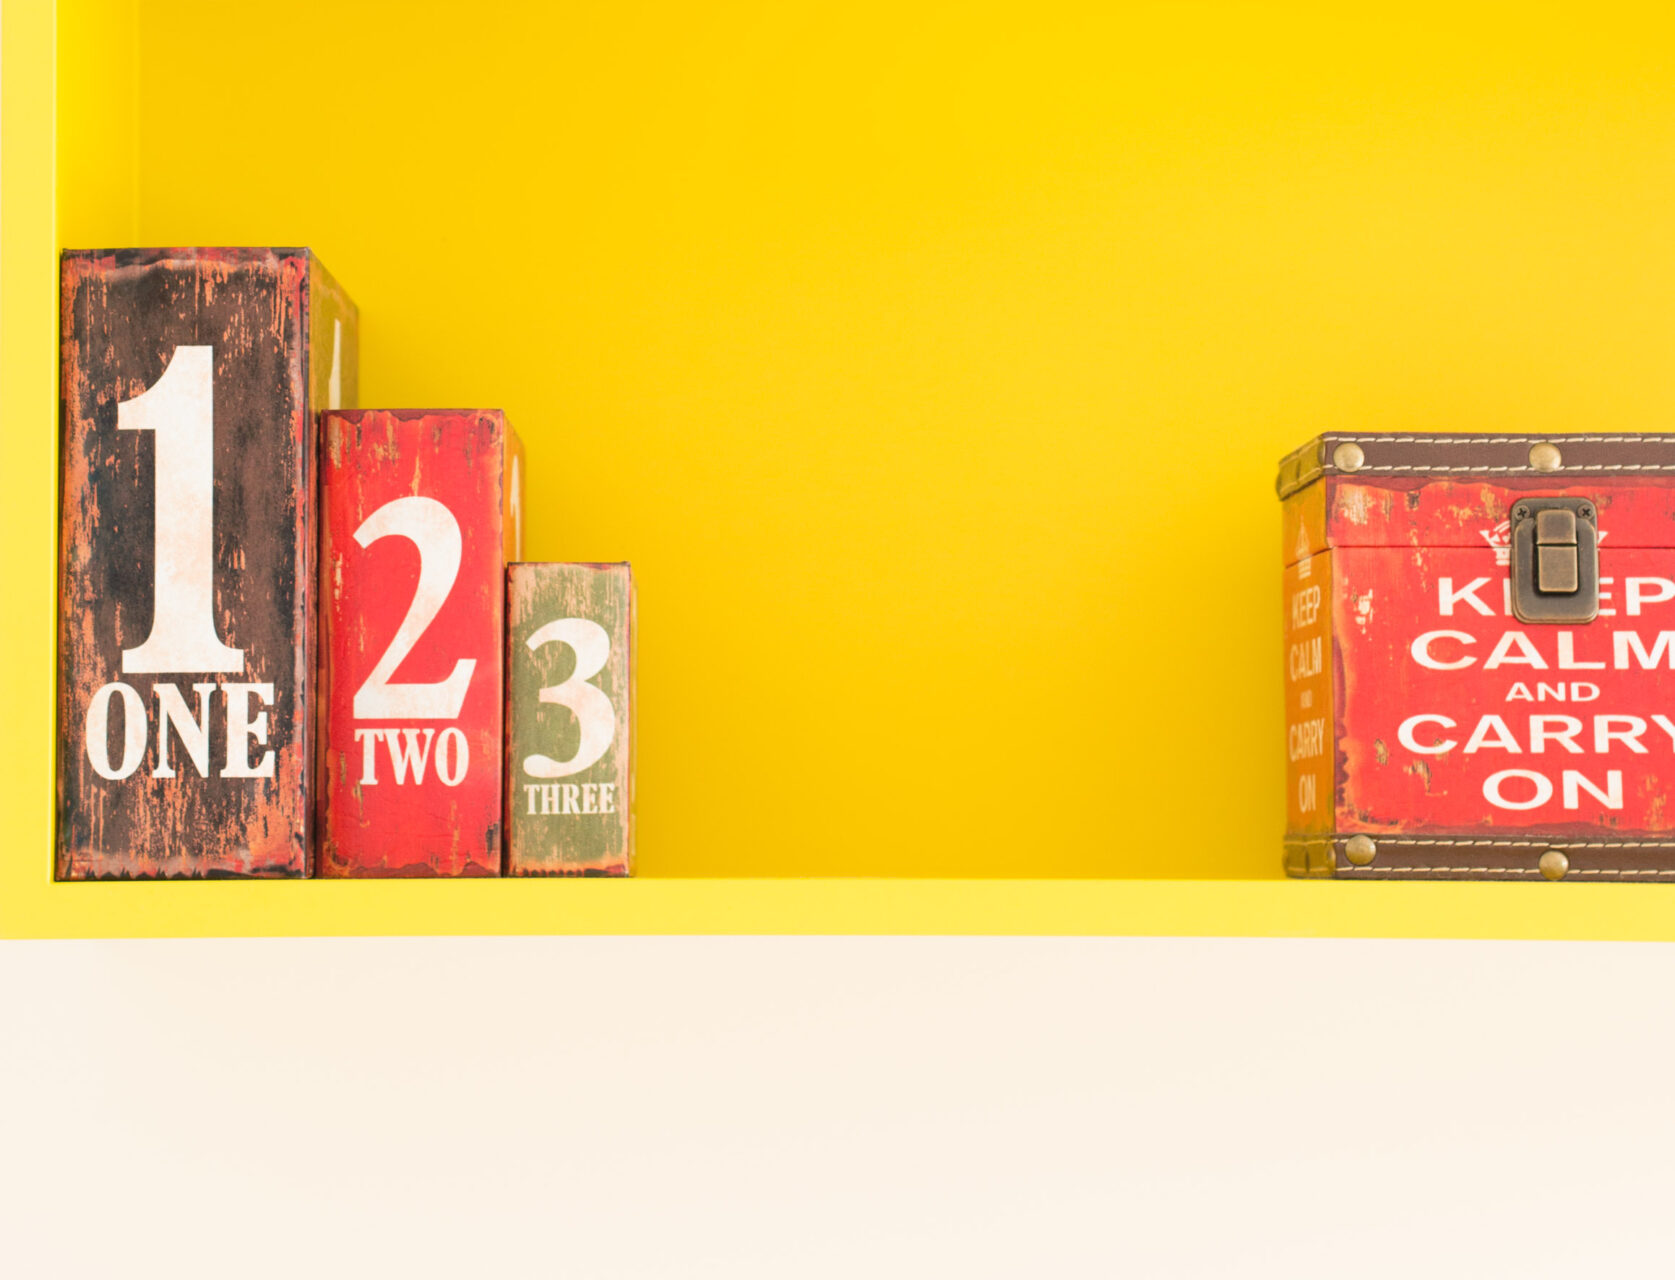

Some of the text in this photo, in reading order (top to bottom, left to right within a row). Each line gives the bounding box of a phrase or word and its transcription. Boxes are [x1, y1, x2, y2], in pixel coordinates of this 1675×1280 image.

[118, 346, 243, 673] 1
[354, 496, 476, 718] 2
[1292, 585, 1321, 630] KEEP
[1439, 577, 1675, 615] KP
[1289, 636, 1322, 682] CALM
[1411, 631, 1675, 669] CALM
[524, 618, 618, 777] 3
[1506, 683, 1599, 701] AND
[86, 682, 275, 780] ONE
[1289, 718, 1325, 762] CARRY
[356, 728, 469, 786] TWO
[524, 783, 615, 814] THREE
[1299, 774, 1316, 813] ON
[1483, 770, 1622, 809] ON
